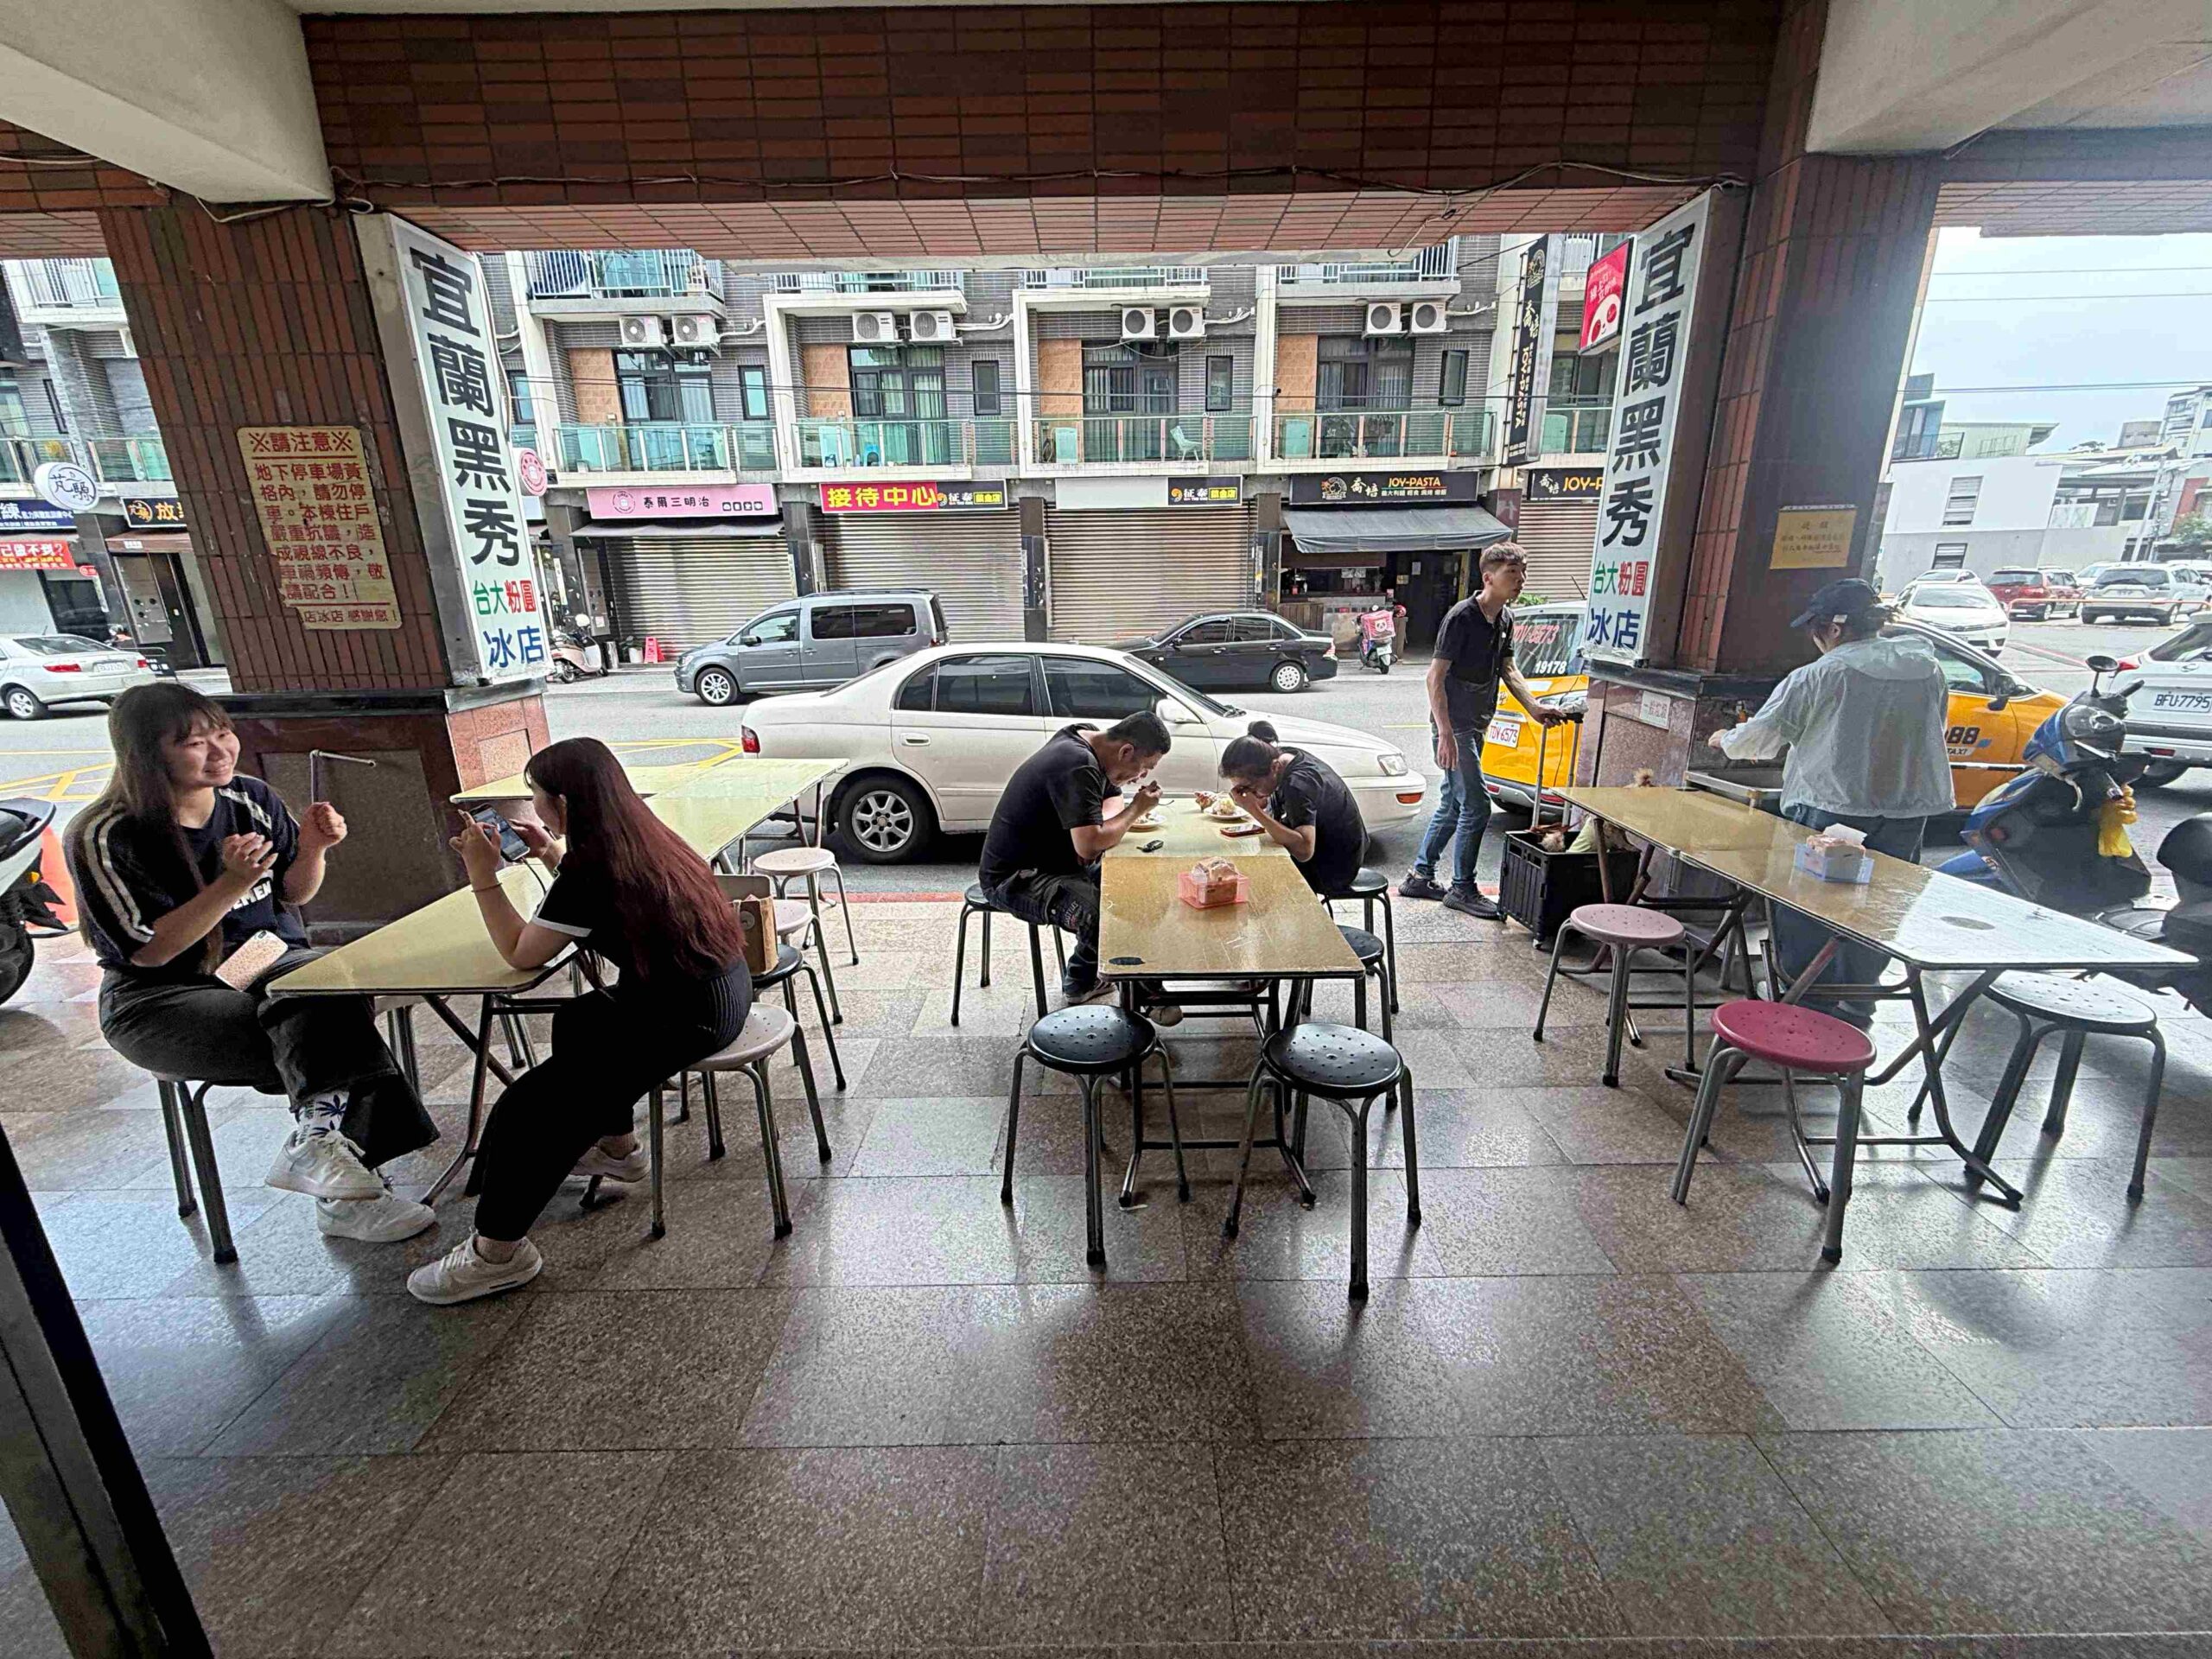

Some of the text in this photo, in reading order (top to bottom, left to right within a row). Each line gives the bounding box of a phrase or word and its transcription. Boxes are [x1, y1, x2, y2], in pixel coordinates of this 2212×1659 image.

[1601, 222, 1695, 547] 宜蘭黑秀
[410, 245, 519, 567] 宜蘭黑秀
[254, 463, 362, 481] 地下停車場黃
[1388, 476, 1441, 487] JOY-PASTA
[827, 486, 937, 508] 接待中心
[1593, 561, 1649, 596] 台大粉圓
[473, 578, 537, 617] 台大粉圓
[1587, 607, 1641, 649] 冰店
[484, 626, 545, 668] 冰店
[1535, 660, 1567, 675] 19178
[2154, 694, 2212, 709] BFU-7795
[1944, 726, 1980, 744] 88
